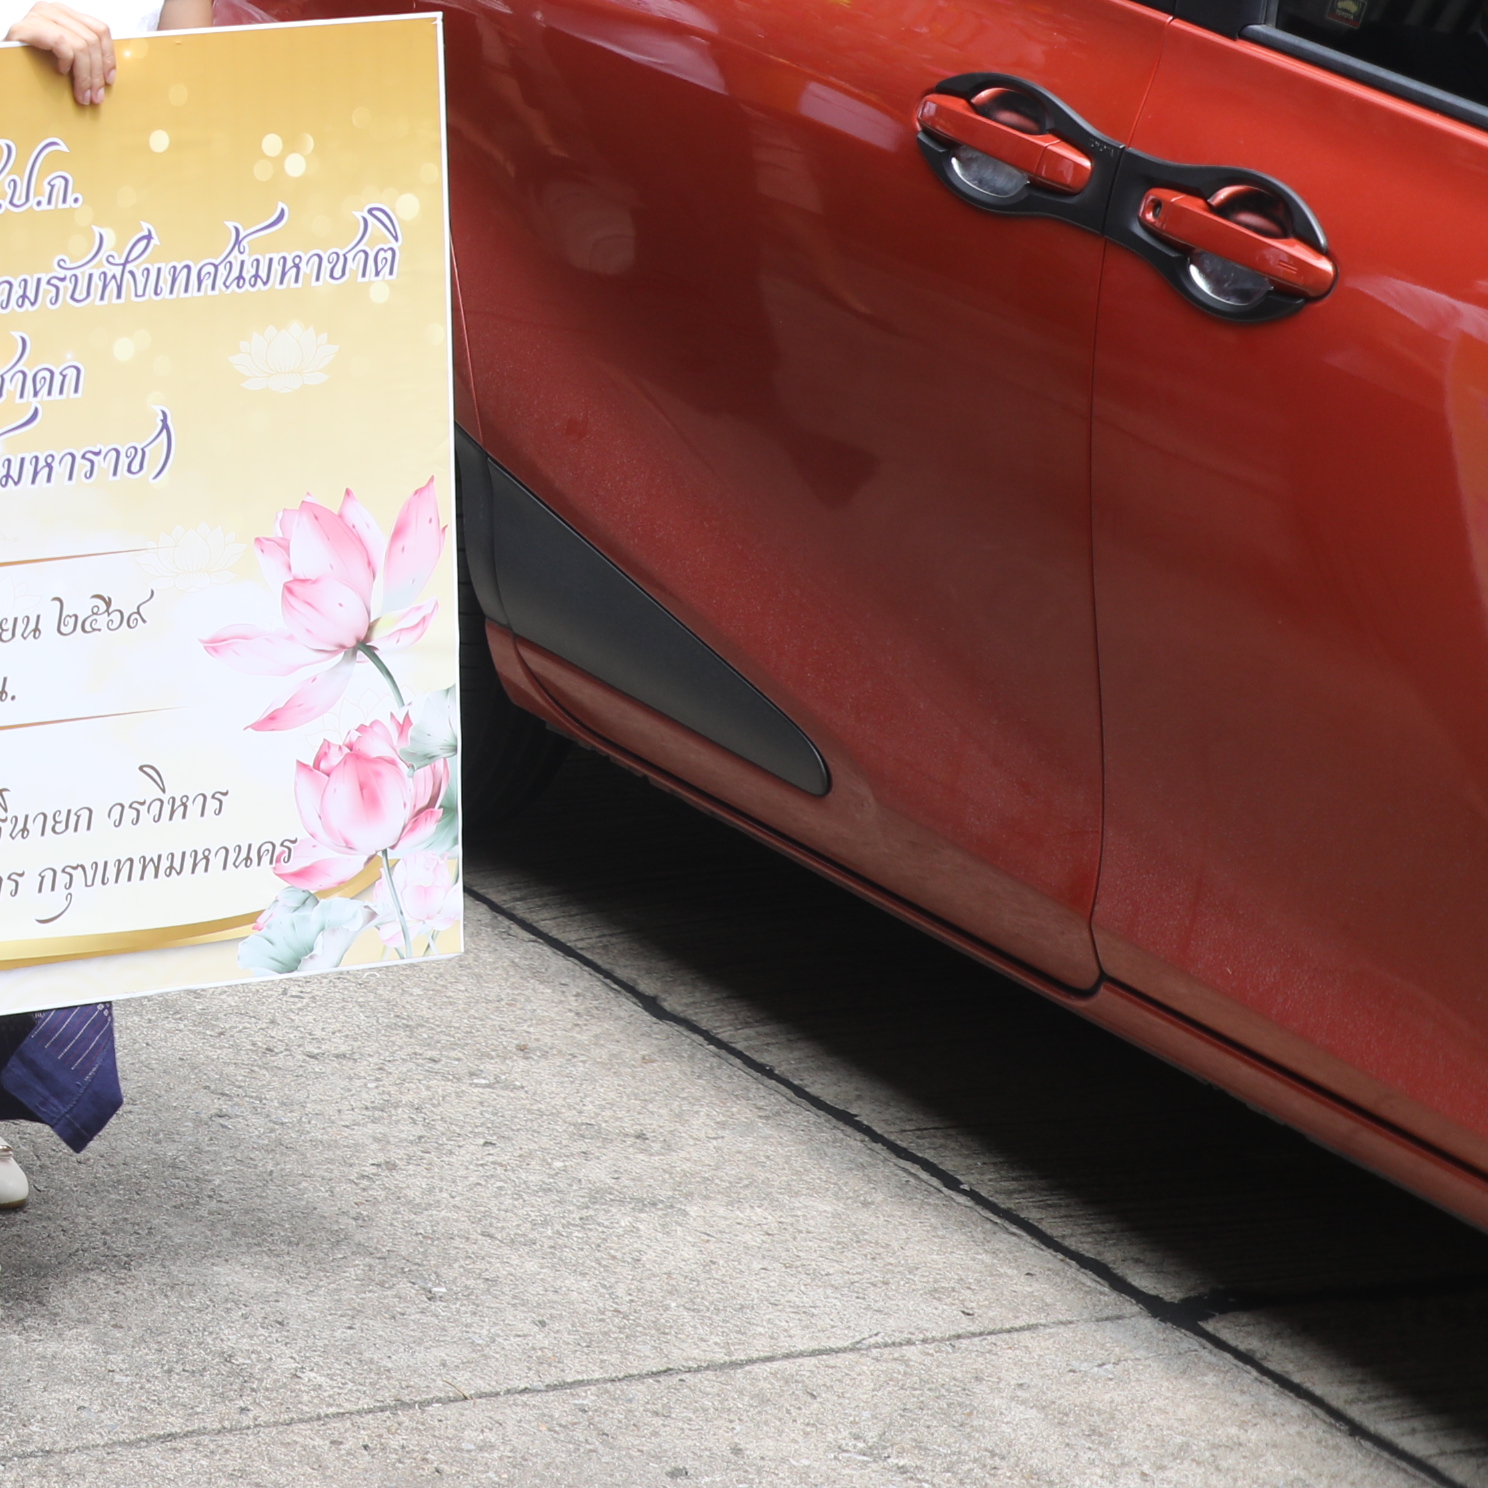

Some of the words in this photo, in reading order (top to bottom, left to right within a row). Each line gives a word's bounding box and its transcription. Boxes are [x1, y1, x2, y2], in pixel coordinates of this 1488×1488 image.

[107, 763, 229, 829] วรวิหาร
[34, 837, 299, 924] กรุงเทพมหานคร
